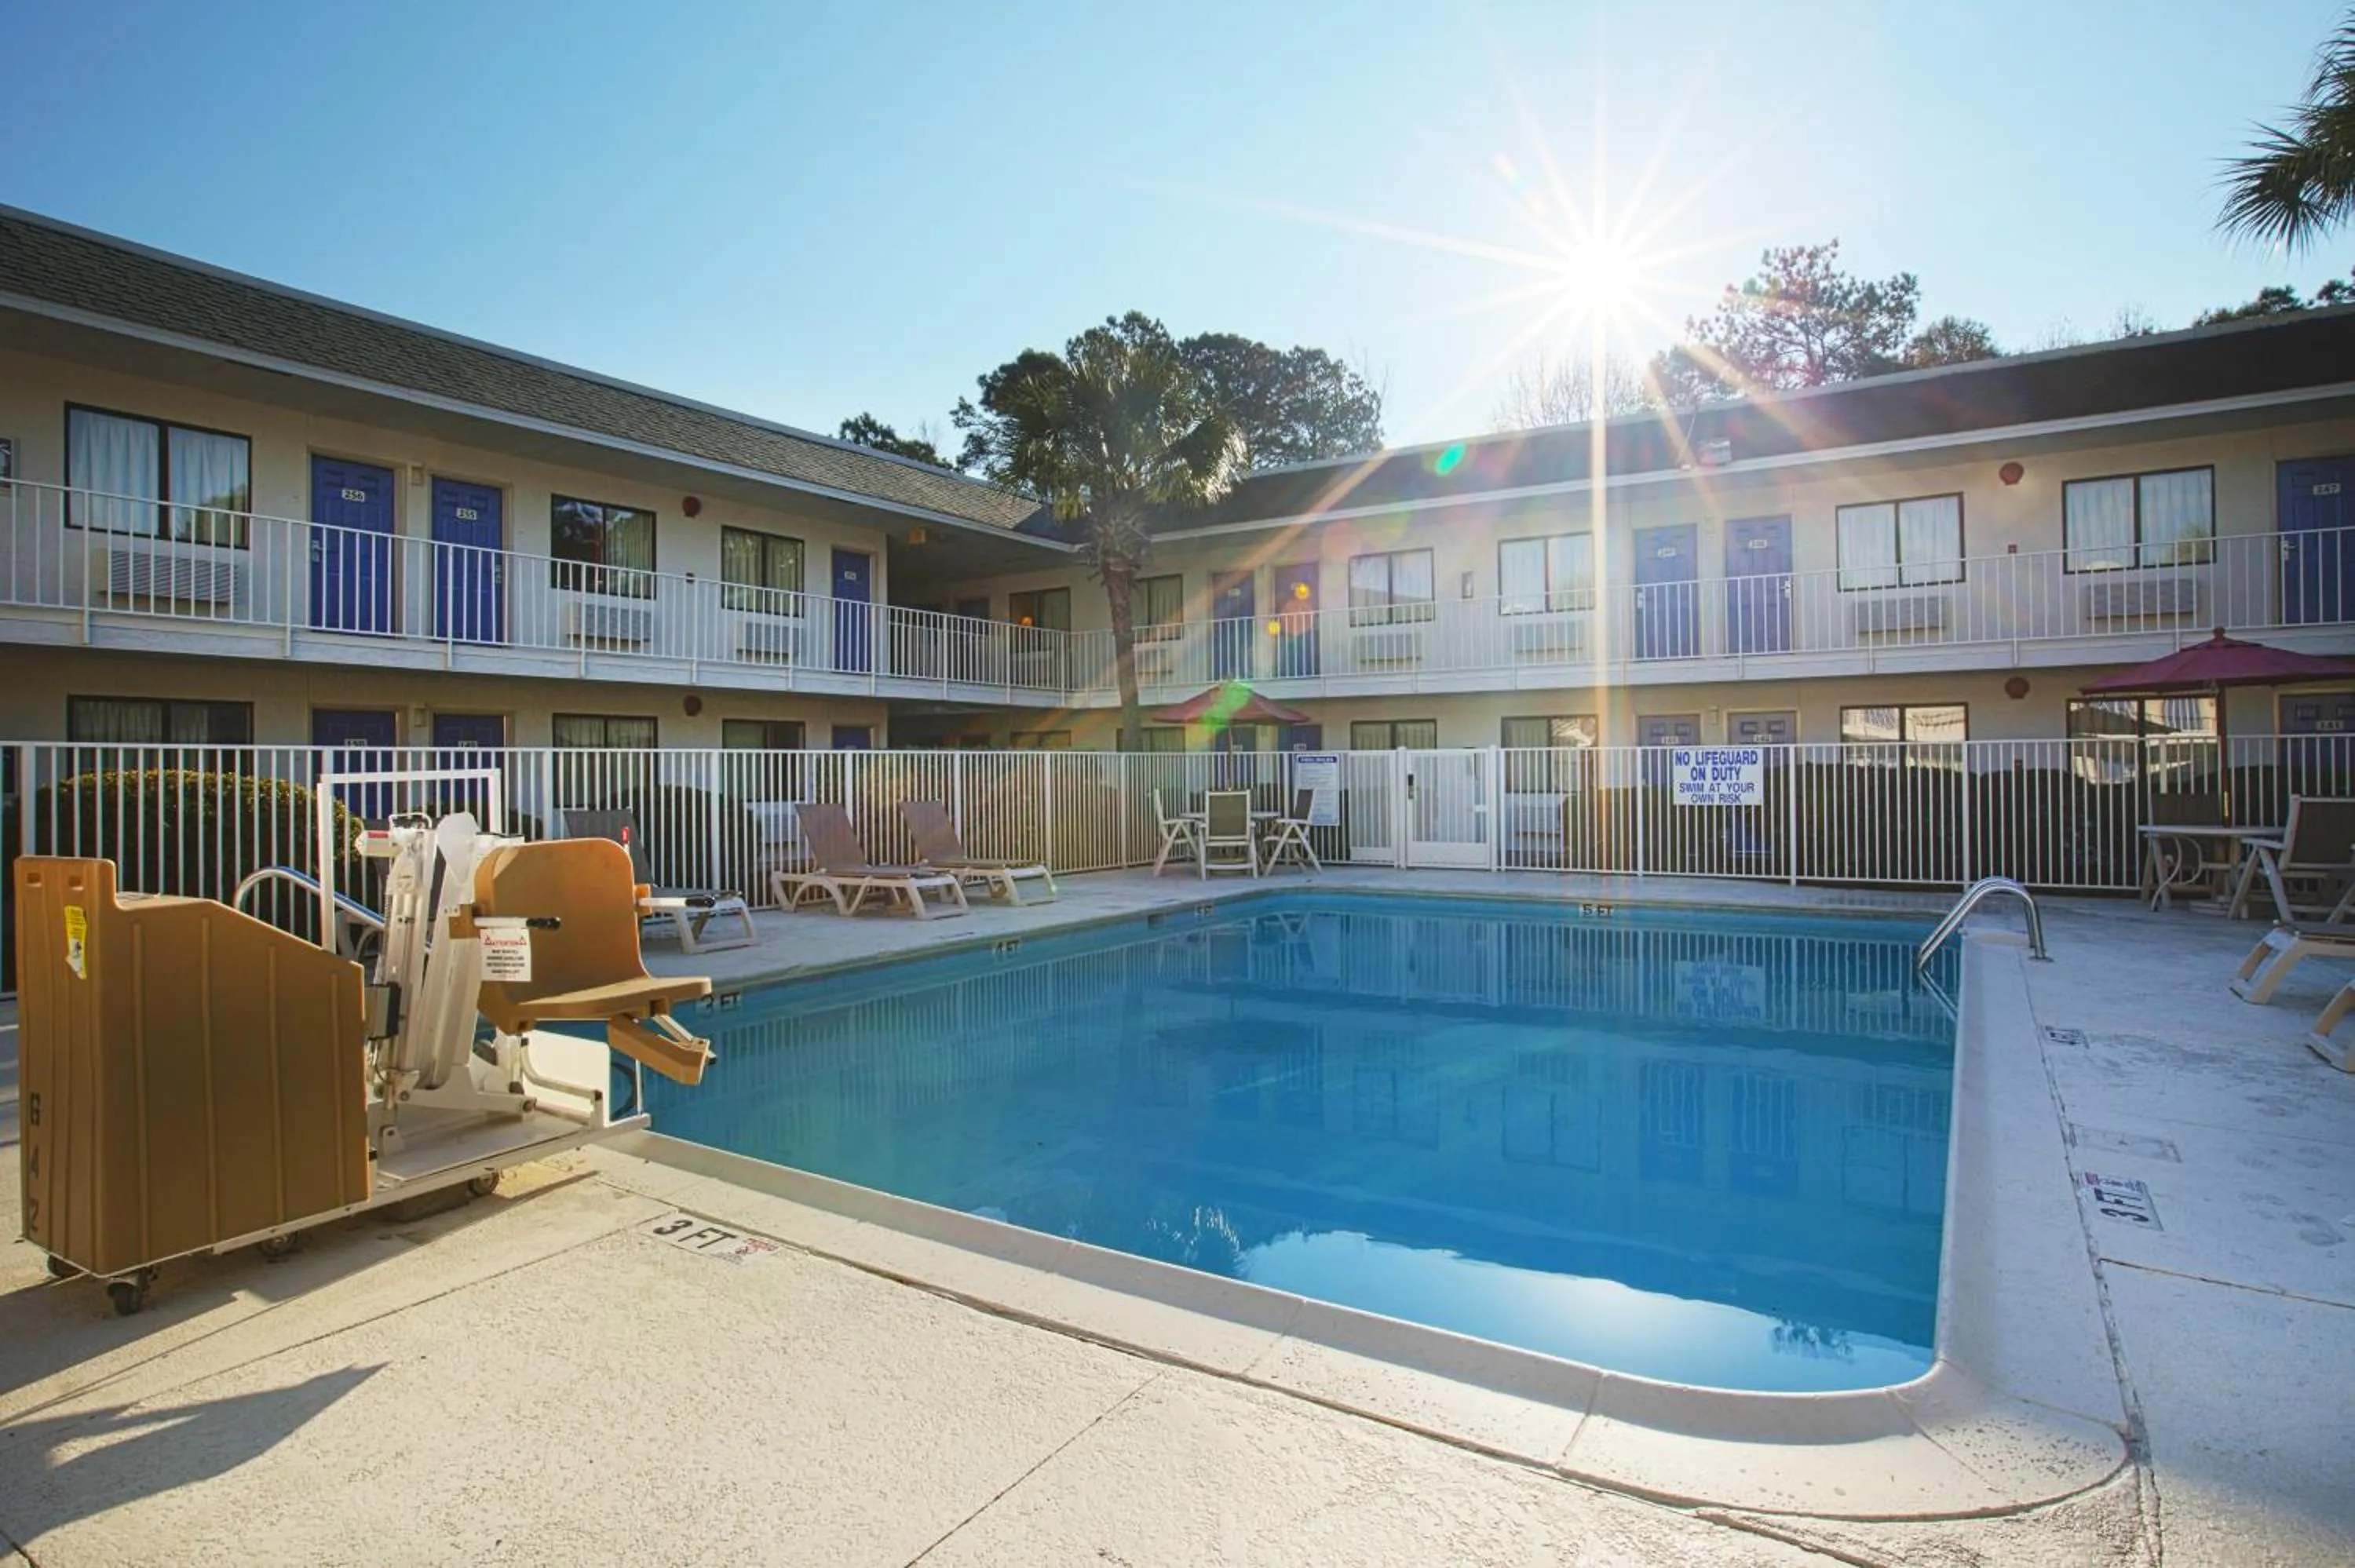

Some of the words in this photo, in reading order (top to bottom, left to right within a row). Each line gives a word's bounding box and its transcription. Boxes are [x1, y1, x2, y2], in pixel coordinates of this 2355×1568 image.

[1675, 751, 1690, 766] NO
[1696, 750, 1758, 766] LIFEGUARD
[1690, 768, 1706, 782] ON
[1712, 768, 1741, 782] DUTY
[1679, 783, 1704, 793] SWIM
[1709, 783, 1721, 793] AT
[1727, 783, 1755, 793] YOUR
[1690, 794, 1714, 804] OWN
[1719, 794, 1742, 804] RISK
[653, 1220, 693, 1234] 3
[678, 1227, 737, 1249] FT
